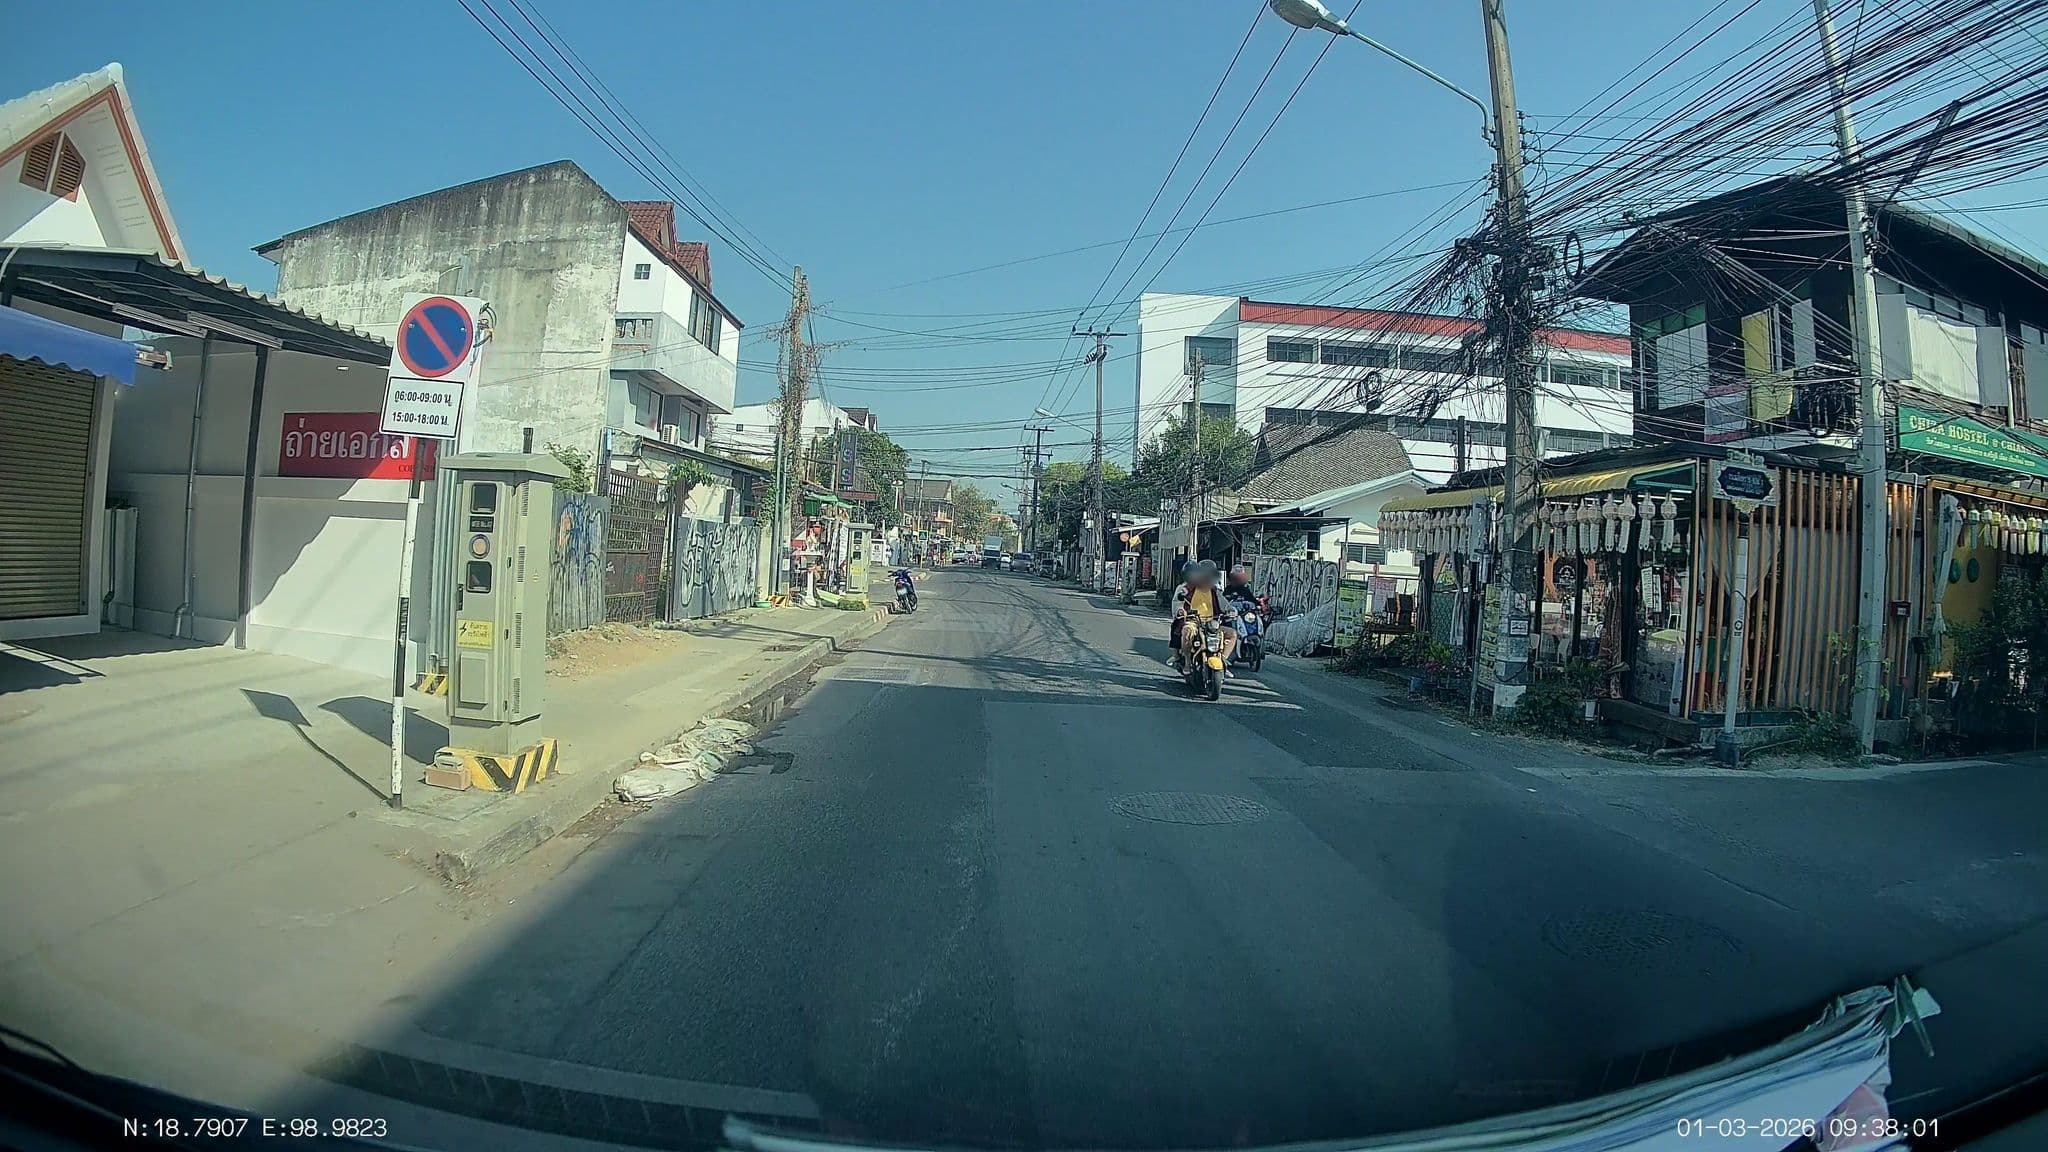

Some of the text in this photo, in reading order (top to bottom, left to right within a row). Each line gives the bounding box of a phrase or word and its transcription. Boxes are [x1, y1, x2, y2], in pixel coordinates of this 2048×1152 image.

[394, 390, 443, 404] 06:00-09:00
[391, 411, 440, 425] 15:00-18:00
[285, 417, 411, 459] ถ่ายเอกส
[1947, 424, 1990, 446] HOSTEL
